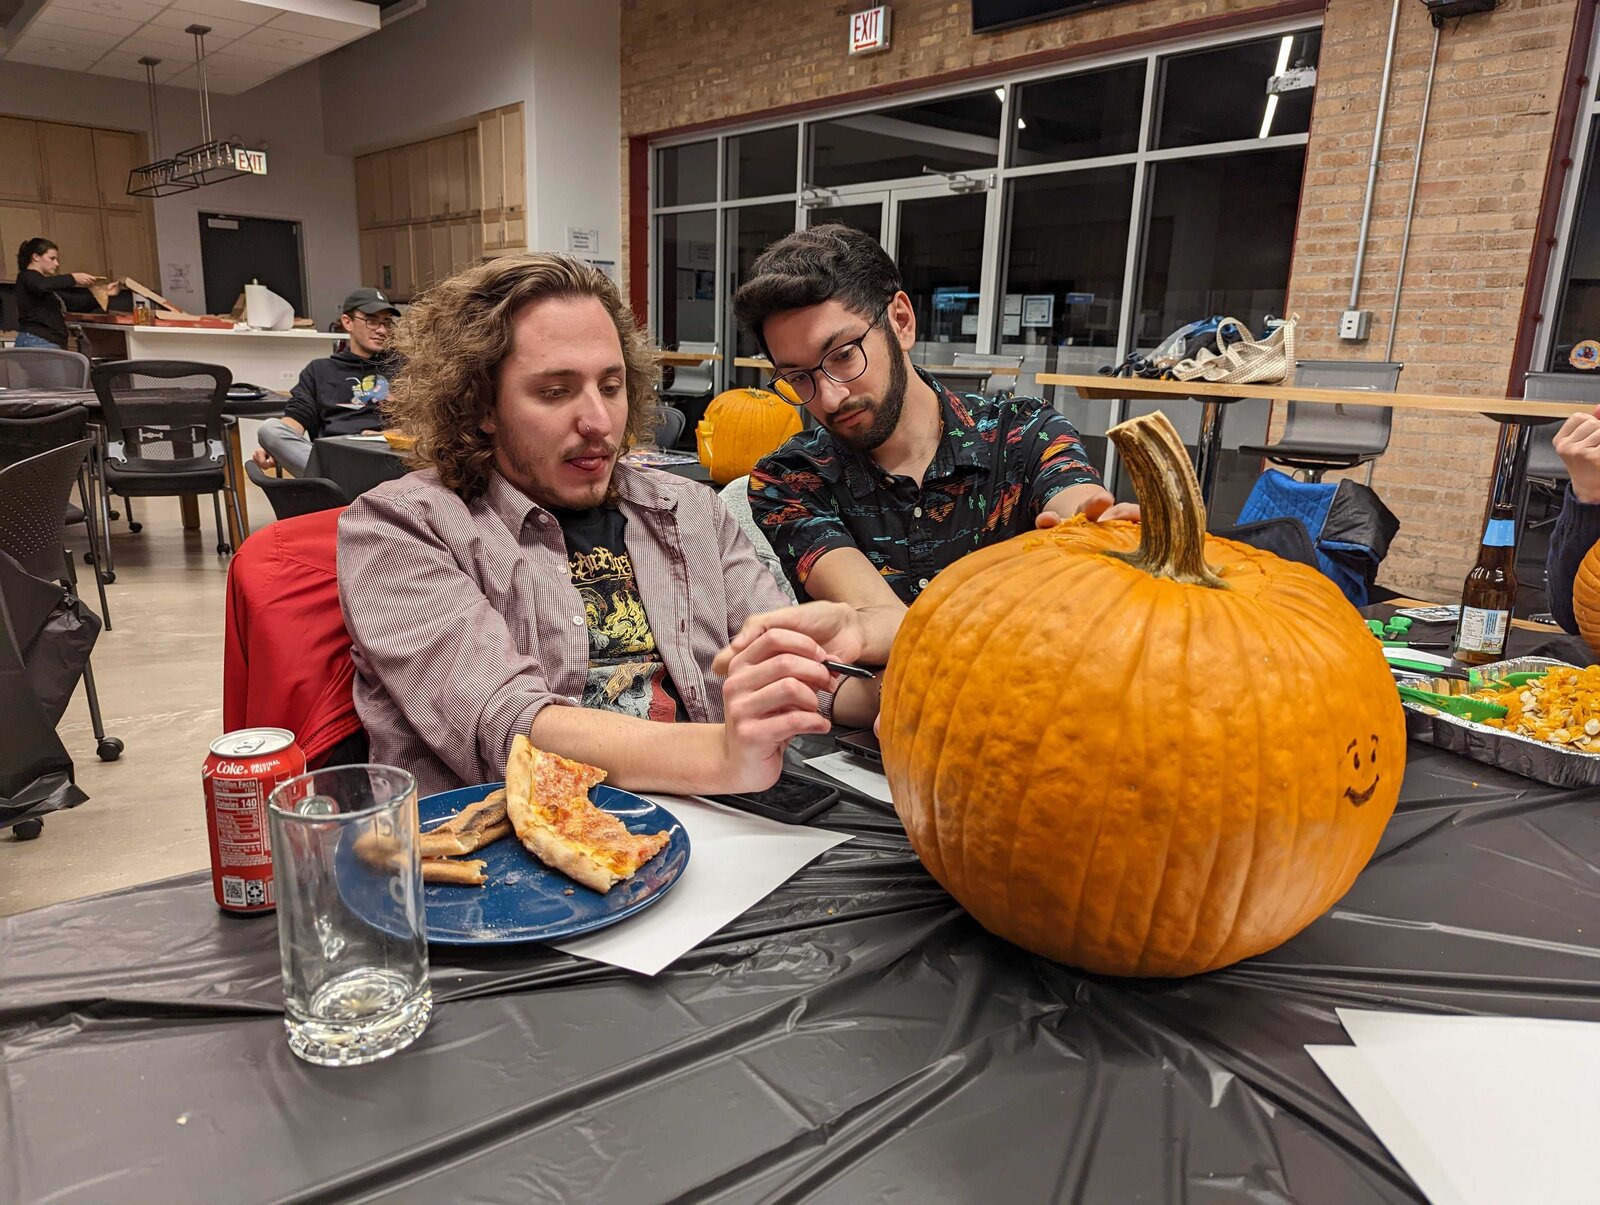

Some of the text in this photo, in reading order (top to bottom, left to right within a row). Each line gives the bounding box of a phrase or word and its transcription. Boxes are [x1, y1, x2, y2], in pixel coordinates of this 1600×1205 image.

[854, 10, 880, 43] EXIT
[239, 152, 263, 171] EXIT
[216, 760, 244, 775] Coke
[250, 759, 280, 769] ORIGINAL
[251, 766, 271, 774] TASTE
[241, 798, 257, 808] 140
